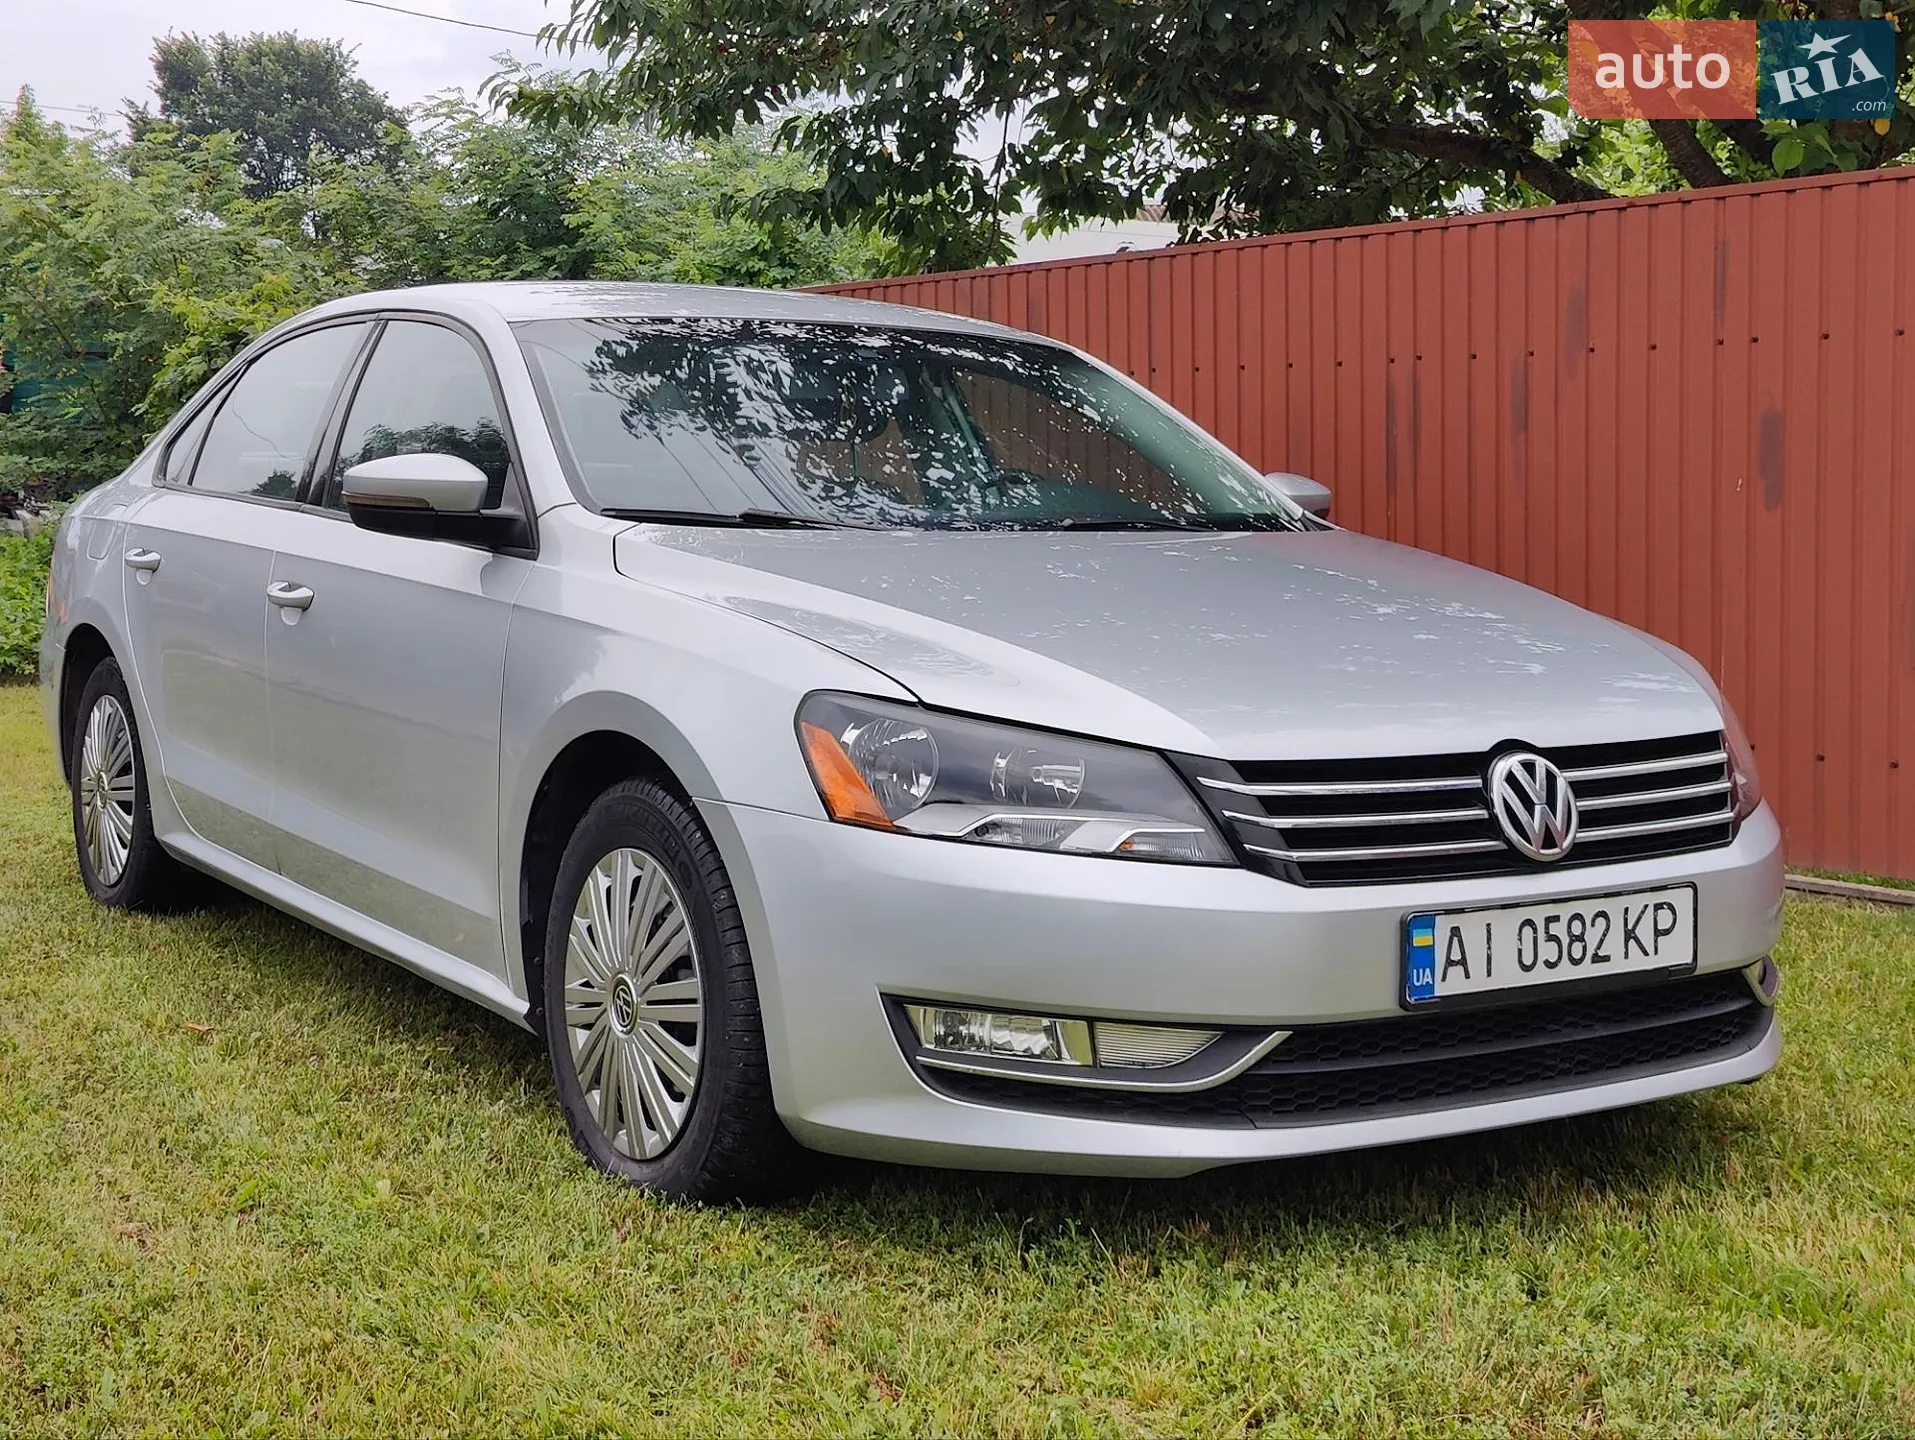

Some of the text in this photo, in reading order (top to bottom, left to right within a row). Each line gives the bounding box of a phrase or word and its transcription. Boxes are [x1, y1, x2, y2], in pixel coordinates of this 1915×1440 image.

[1441, 901, 1678, 982] AI 0582 KP
[1412, 968, 1433, 986] UA
